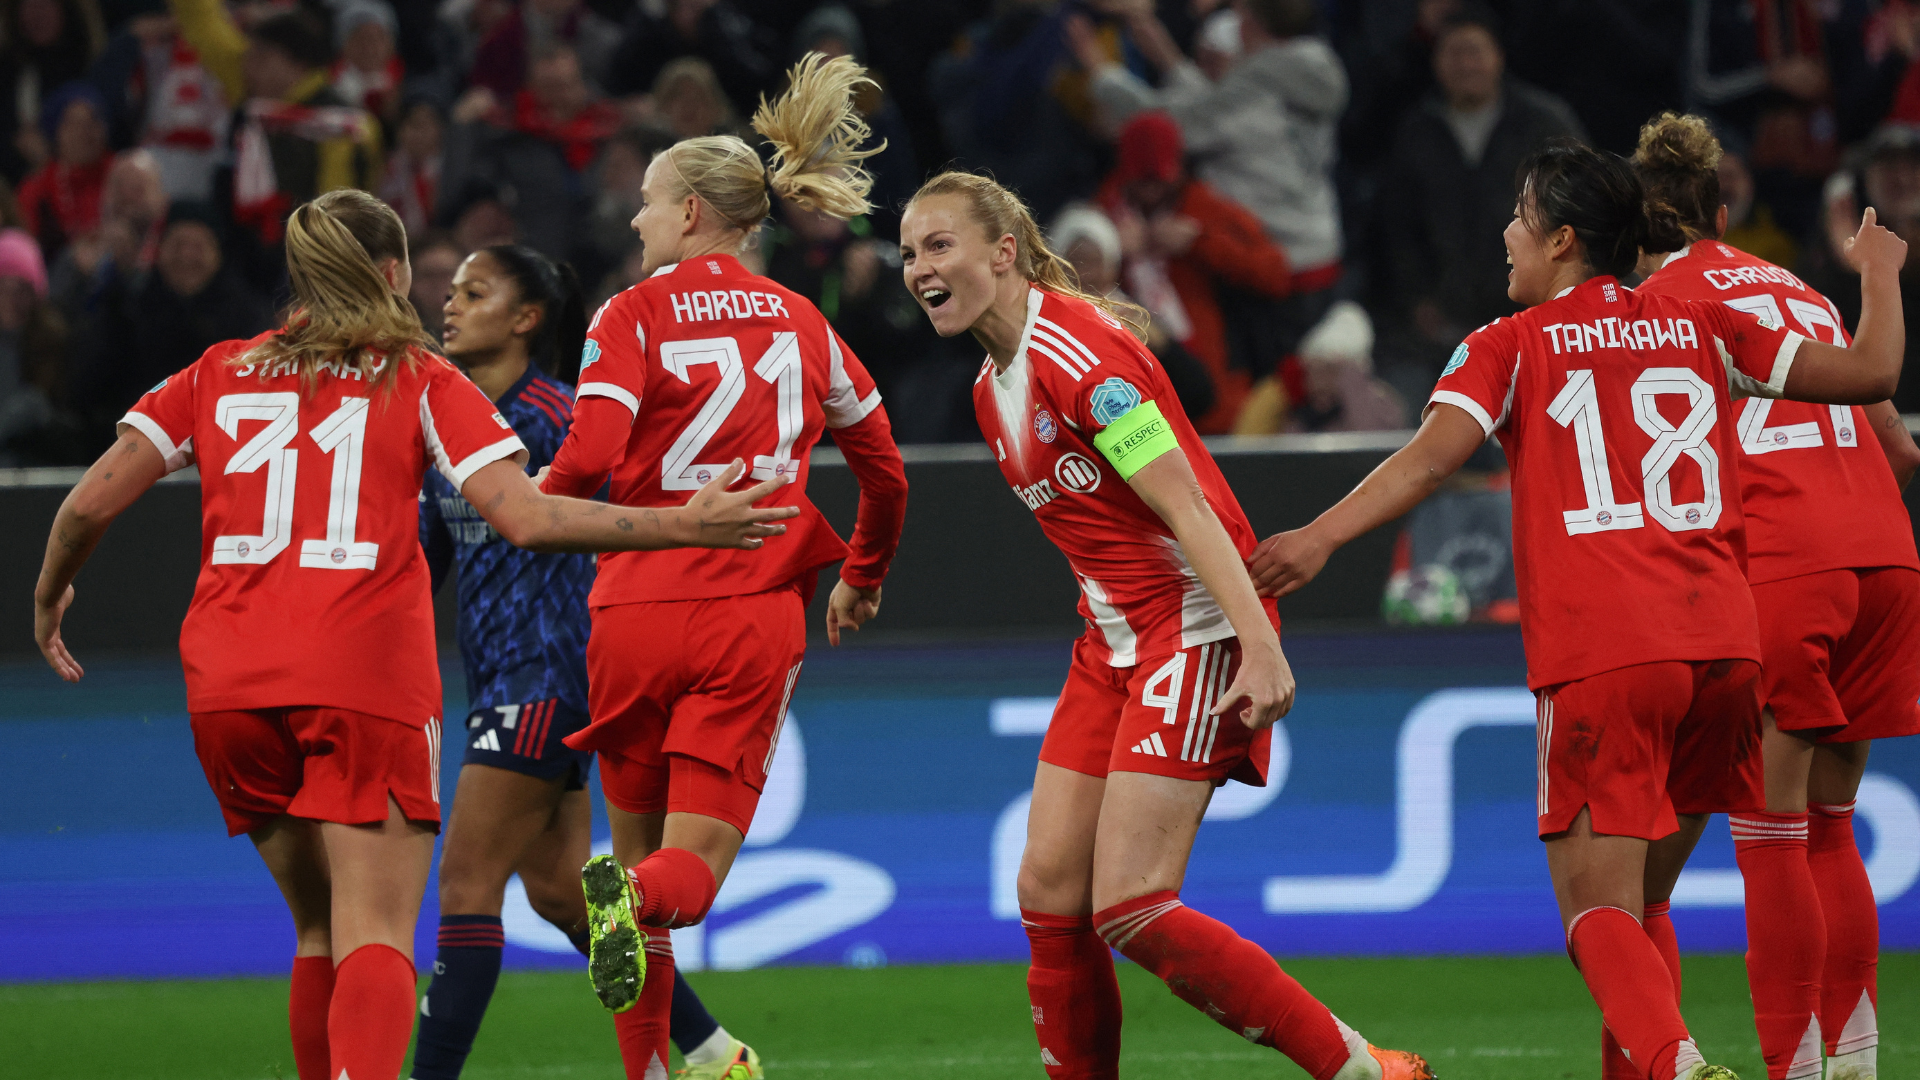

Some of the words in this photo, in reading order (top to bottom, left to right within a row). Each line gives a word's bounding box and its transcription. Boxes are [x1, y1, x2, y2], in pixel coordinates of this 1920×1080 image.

[1602, 283, 1614, 291] MIA
[1703, 266, 1805, 291] CARUSO
[670, 290, 790, 323] HARDER
[1543, 317, 1699, 355] TANIKAWA
[235, 351, 388, 383] SAWAY
[660, 332, 804, 491] 21
[1124, 421, 1163, 450] RESPECT
[1546, 367, 1722, 537] 18
[212, 391, 380, 571] 31
[1011, 478, 1061, 512] lianz
[1142, 651, 1188, 725] 4
